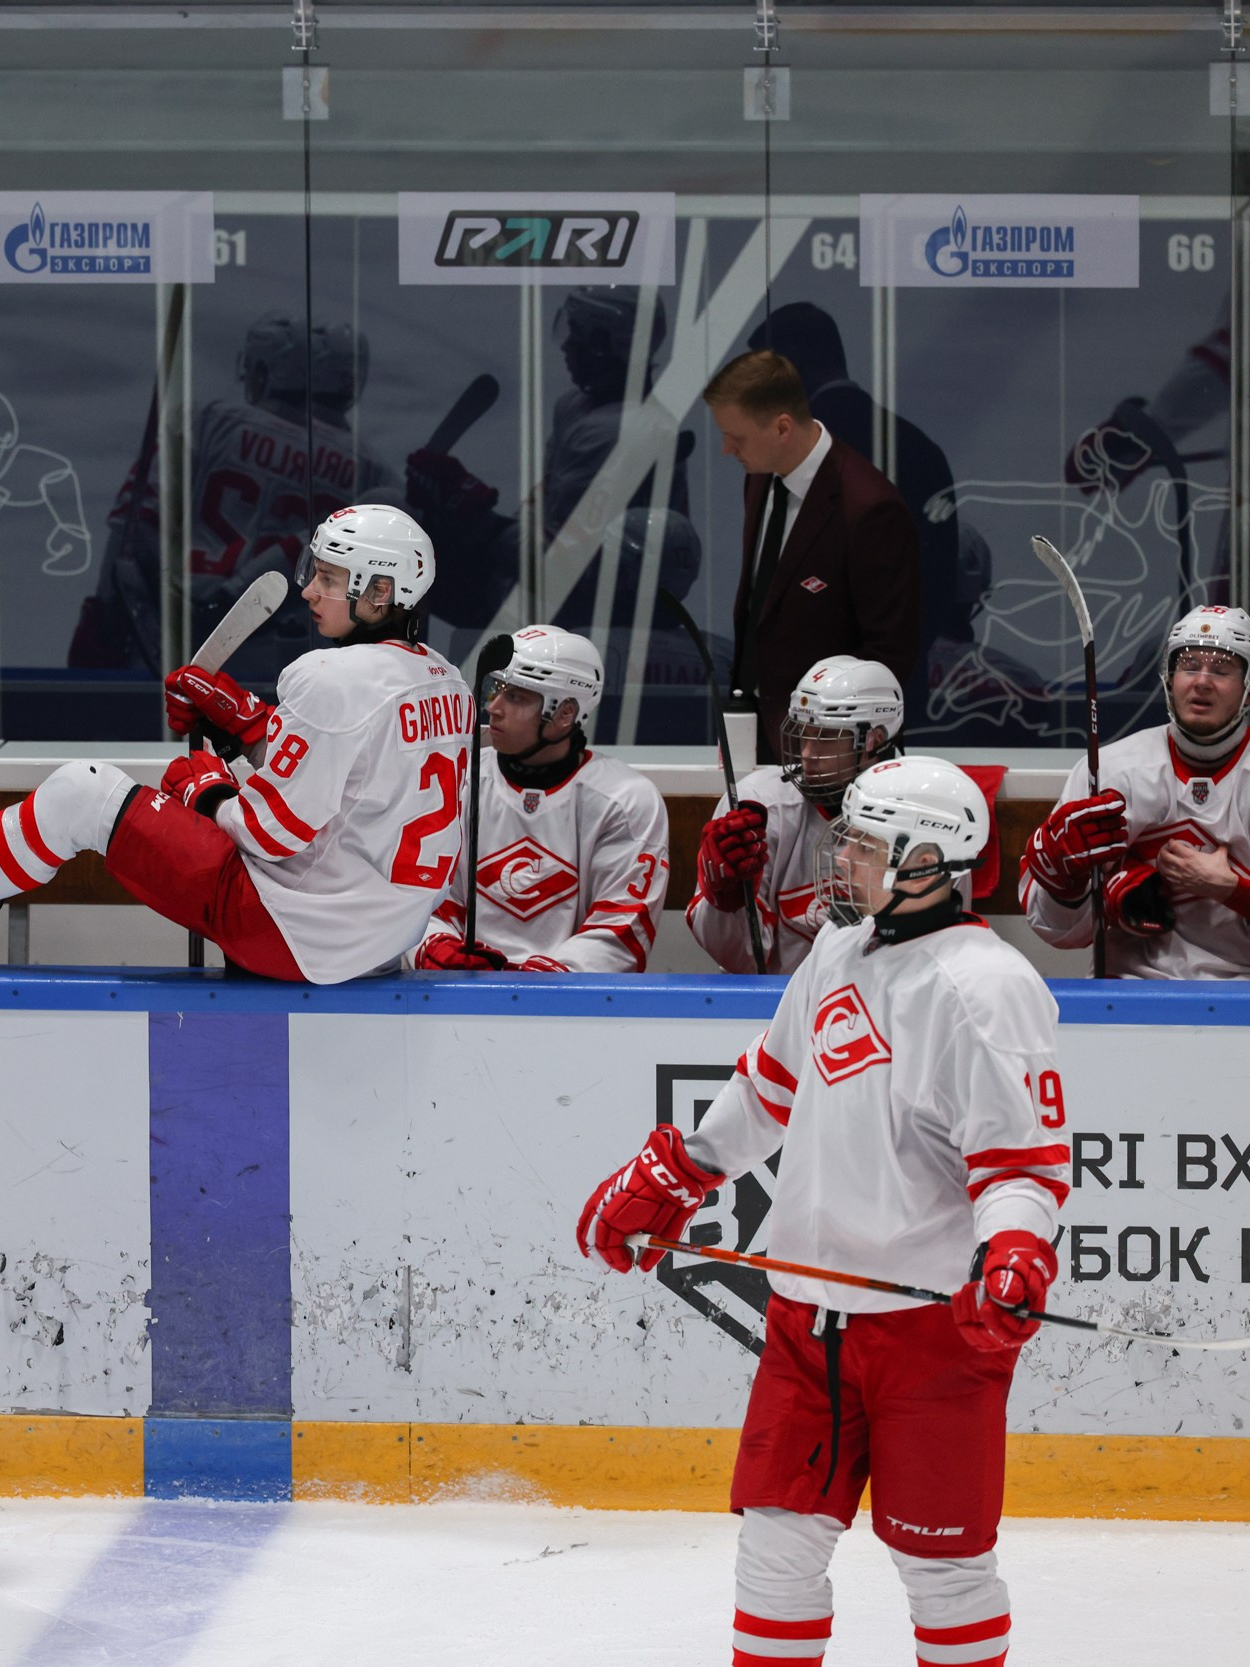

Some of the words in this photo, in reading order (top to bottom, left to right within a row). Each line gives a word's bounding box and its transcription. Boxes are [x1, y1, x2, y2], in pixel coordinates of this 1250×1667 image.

[50, 222, 150, 248] ГАЗПРОМ
[444, 217, 630, 259] PARI
[971, 226, 1074, 252] ГАЗПРОМ
[812, 233, 857, 270] 64
[1168, 234, 1215, 271] 66
[55, 259, 147, 271] ЭКСПОРТ
[976, 262, 1071, 275] ЭКСПОРТ
[368, 560, 398, 568] CCM
[517, 629, 548, 640] 37
[569, 678, 593, 690] CCM
[812, 668, 828, 683] 4
[875, 706, 897, 714] CCM
[1090, 698, 1099, 735] CCM
[266, 714, 310, 779] 28
[919, 819, 954, 832] CCM
[909, 866, 939, 879] BAUER
[1023, 1069, 1067, 1129] 19
[639, 1145, 700, 1209] CCM
[886, 1515, 965, 1537] TRUE
